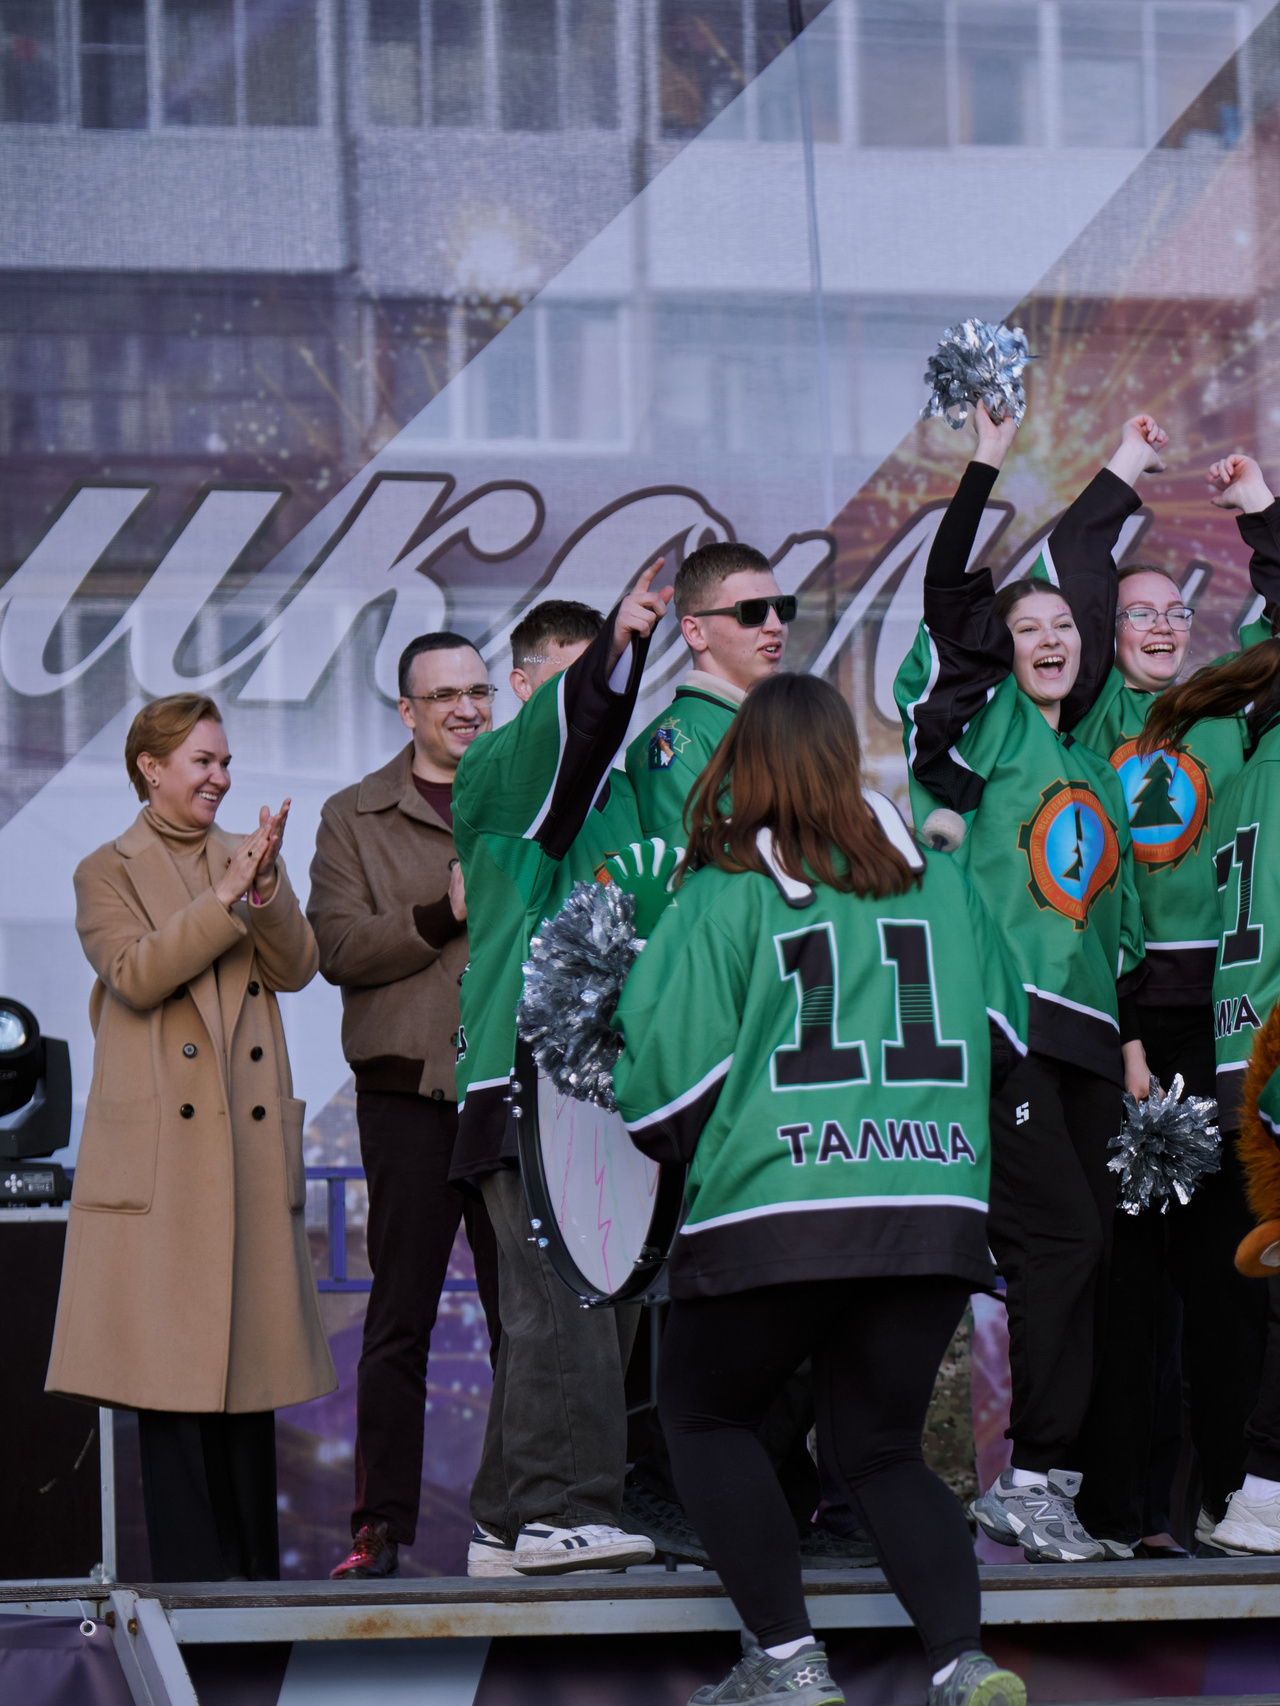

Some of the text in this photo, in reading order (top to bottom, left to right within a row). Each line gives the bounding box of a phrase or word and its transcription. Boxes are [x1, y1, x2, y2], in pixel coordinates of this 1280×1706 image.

[769, 918, 969, 1092] 11
[1214, 993, 1263, 1040] ИЦА
[777, 1118, 976, 1166] ТАЛИЦА
